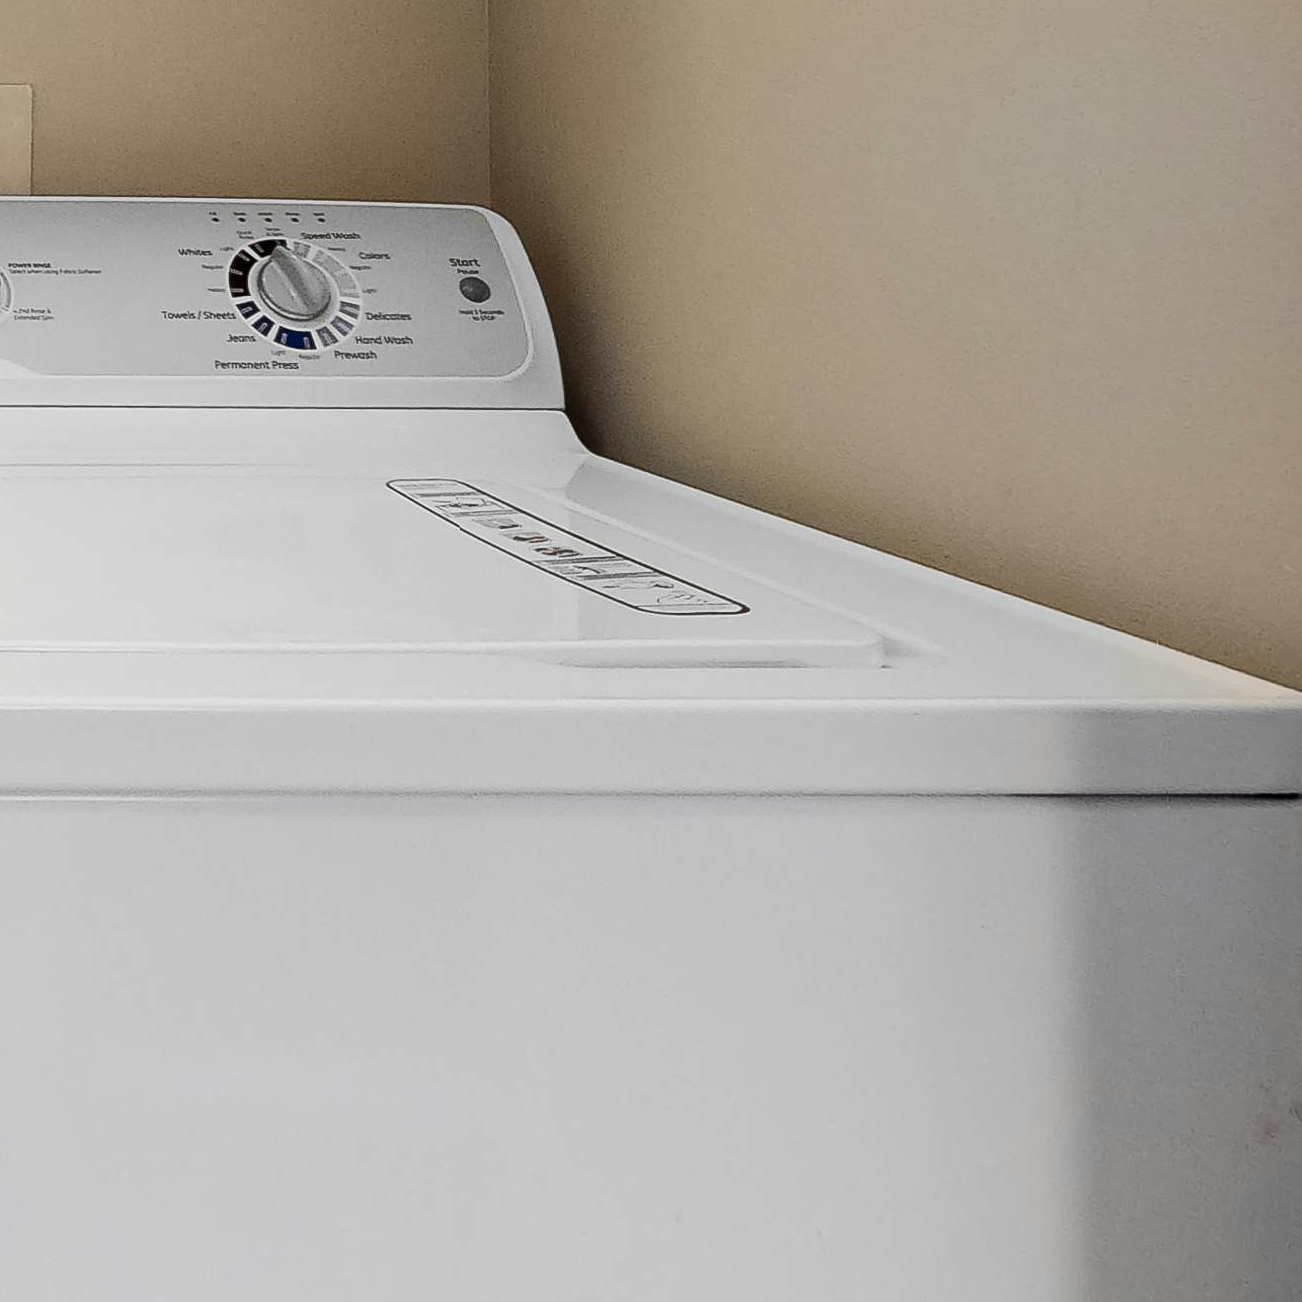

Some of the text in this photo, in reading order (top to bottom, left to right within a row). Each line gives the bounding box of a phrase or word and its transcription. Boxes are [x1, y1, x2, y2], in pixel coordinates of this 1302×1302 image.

[301, 232, 361, 241] Speed Wash
[178, 249, 213, 257] Whites
[358, 252, 391, 260] Colors
[449, 258, 482, 267] Start
[161, 311, 238, 320] Towels Sheets
[365, 312, 412, 321] Delicates
[227, 334, 257, 343] Jeans
[355, 336, 414, 345] Hand Wash
[334, 350, 377, 360] Prewash
[214, 360, 299, 370] Permanent Press
